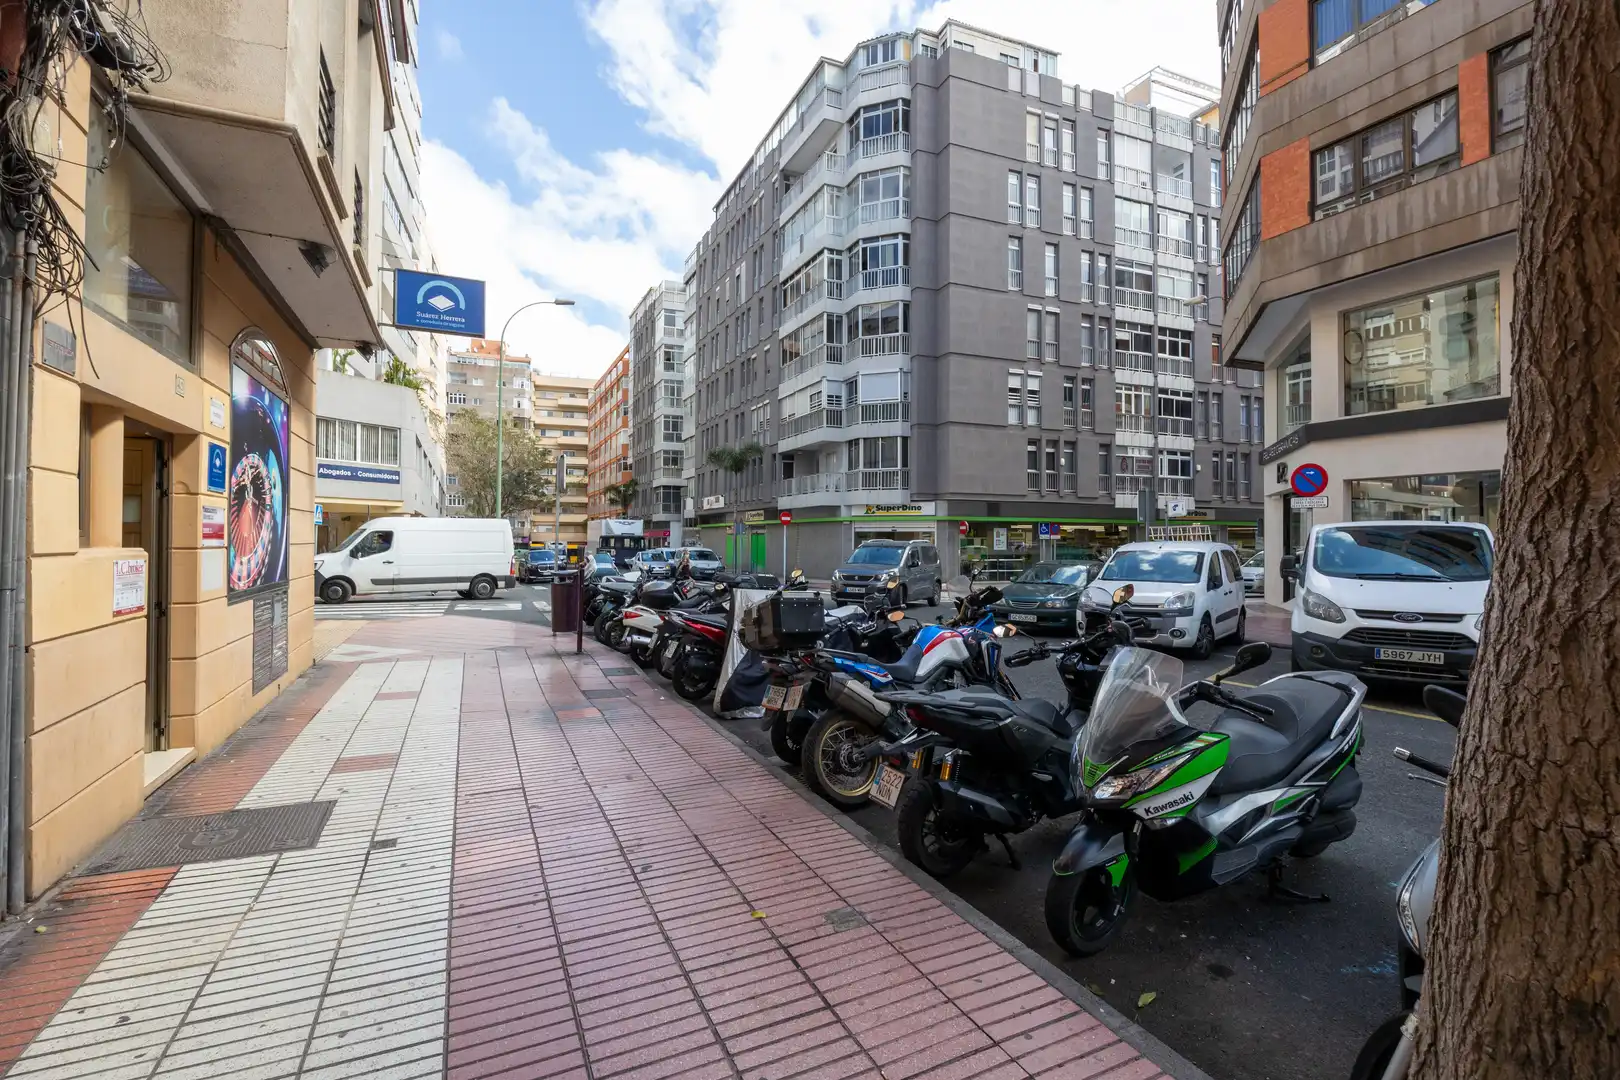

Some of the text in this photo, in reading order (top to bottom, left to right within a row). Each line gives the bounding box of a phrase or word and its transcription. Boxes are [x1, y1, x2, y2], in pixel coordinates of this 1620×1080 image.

[416, 311, 466, 323] Suárez Herrera
[318, 467, 352, 477] Abogados
[357, 471, 400, 480] Consumidores
[875, 504, 922, 512] SuperDino
[1383, 650, 1442, 663] 5967 JYH
[881, 769, 903, 790] 2522
[1144, 791, 1195, 817] Kawasaki
